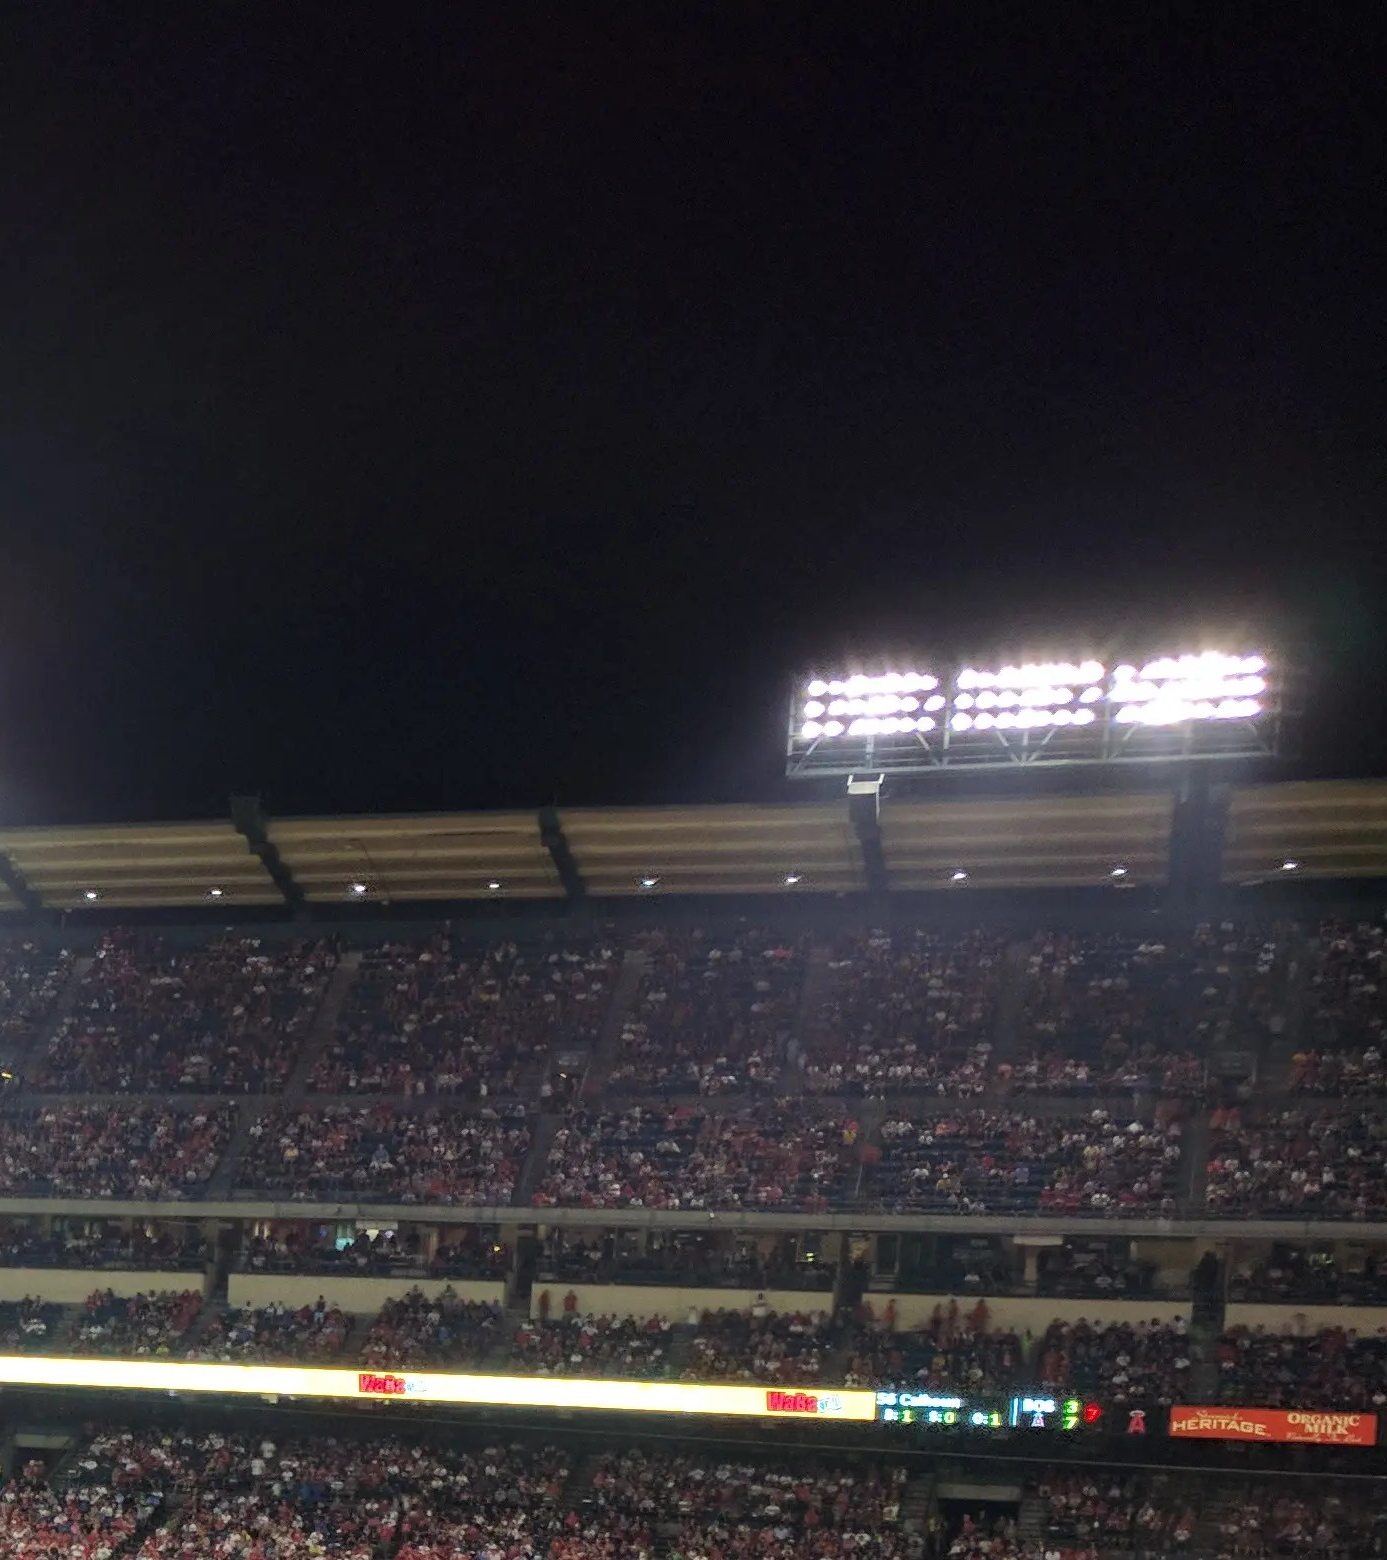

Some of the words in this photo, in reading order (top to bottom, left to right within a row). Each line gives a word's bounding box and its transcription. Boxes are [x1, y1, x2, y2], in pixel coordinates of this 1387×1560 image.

[359, 1374, 406, 1394] WaBa
[766, 1391, 818, 1413] WaBa
[1172, 1418, 1267, 1436] HERITAGE
[1286, 1412, 1361, 1427] ORGANIC
[1303, 1423, 1349, 1435] MILK
